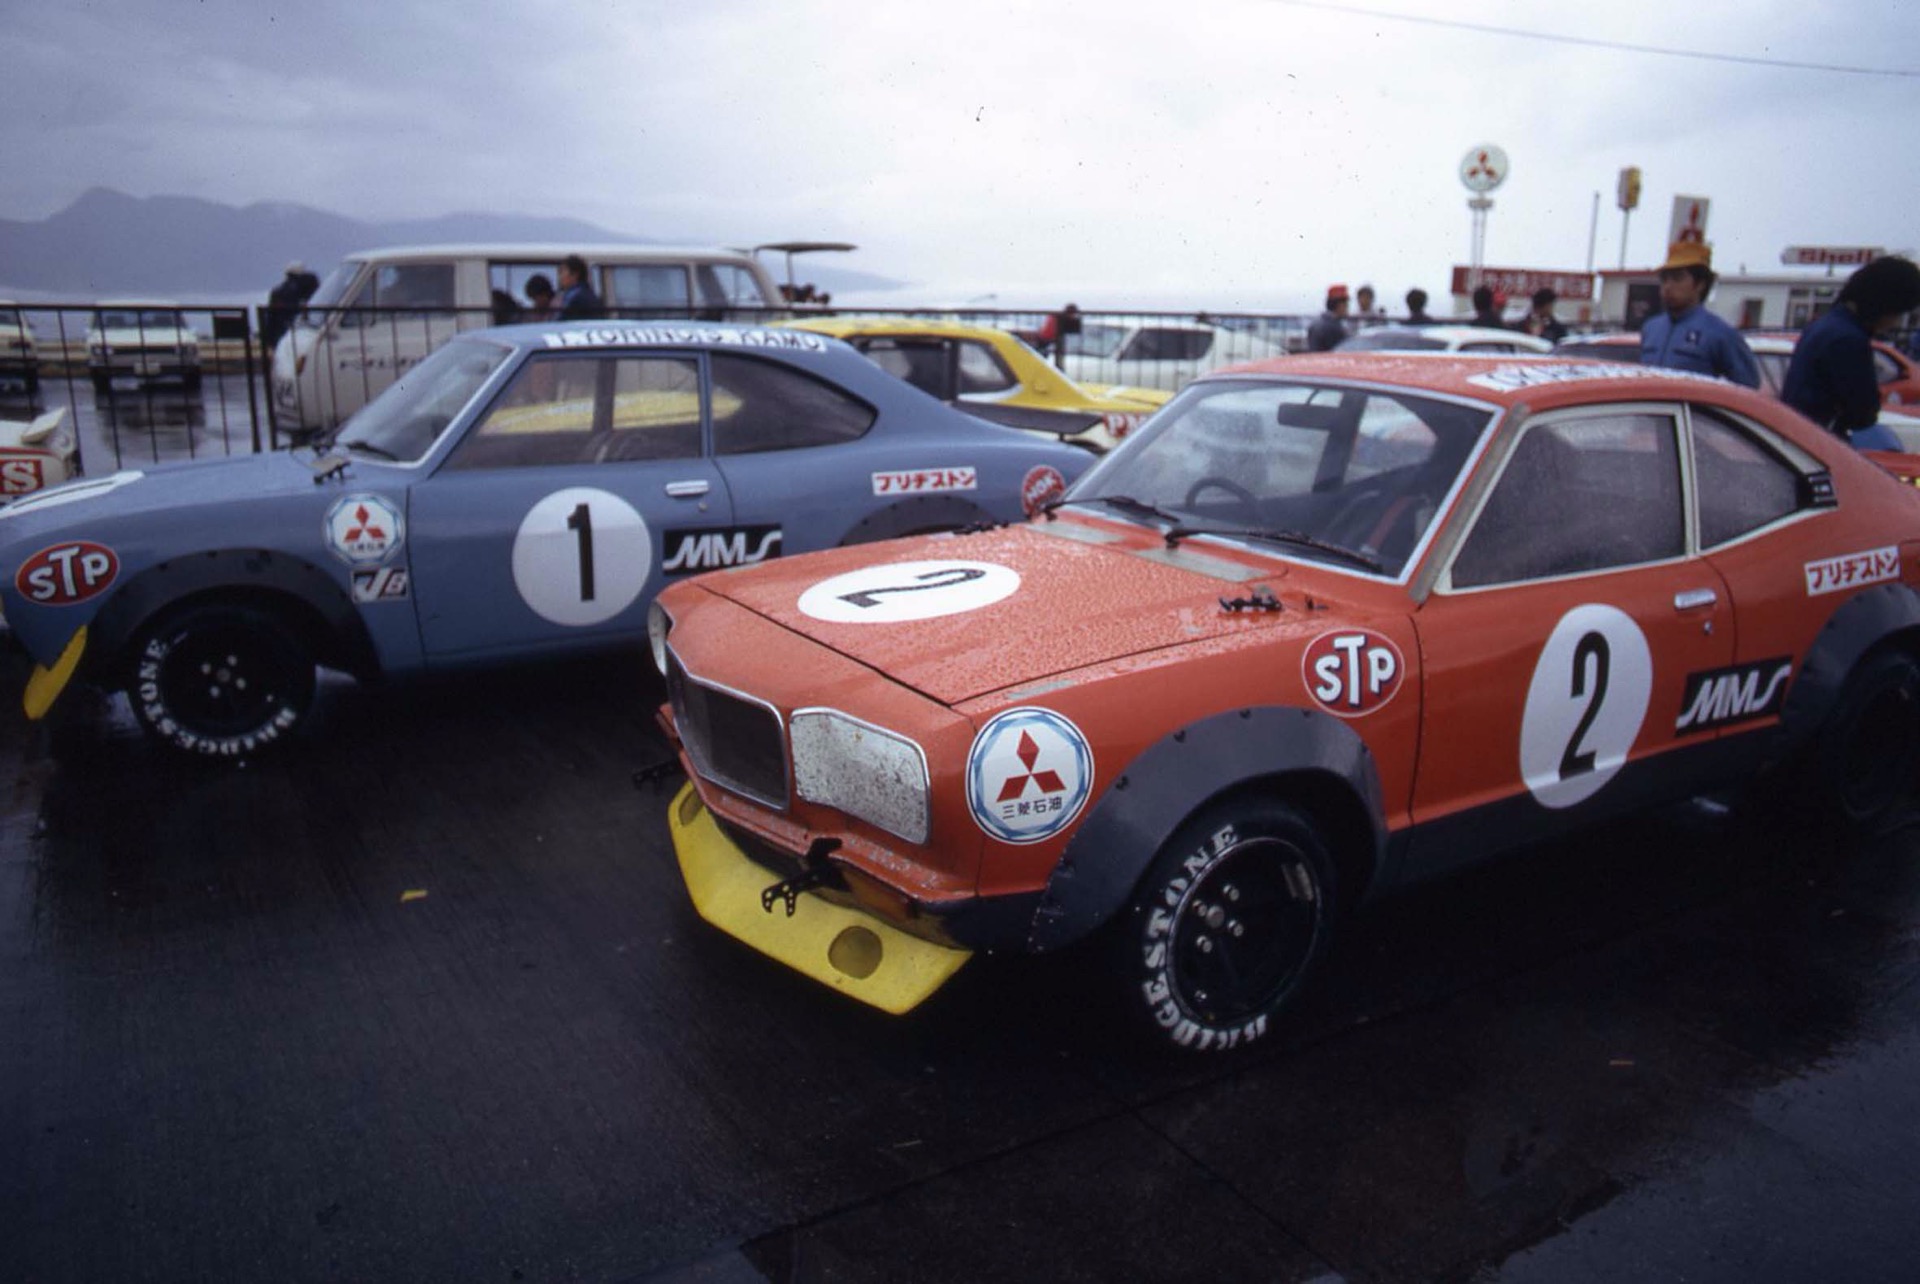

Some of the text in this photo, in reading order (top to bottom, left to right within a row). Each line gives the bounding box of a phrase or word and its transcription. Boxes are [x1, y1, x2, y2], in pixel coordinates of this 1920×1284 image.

[28, 546, 110, 599] STP
[566, 503, 595, 601] 1
[662, 530, 782, 570] MMS
[836, 568, 987, 608] 2
[1315, 634, 1396, 706] STP
[1675, 664, 1792, 729] MMS
[1559, 630, 1610, 782] 2
[1002, 796, 1062, 819] 三菱石油
[1142, 824, 1267, 1050] BRIDGESTONE
